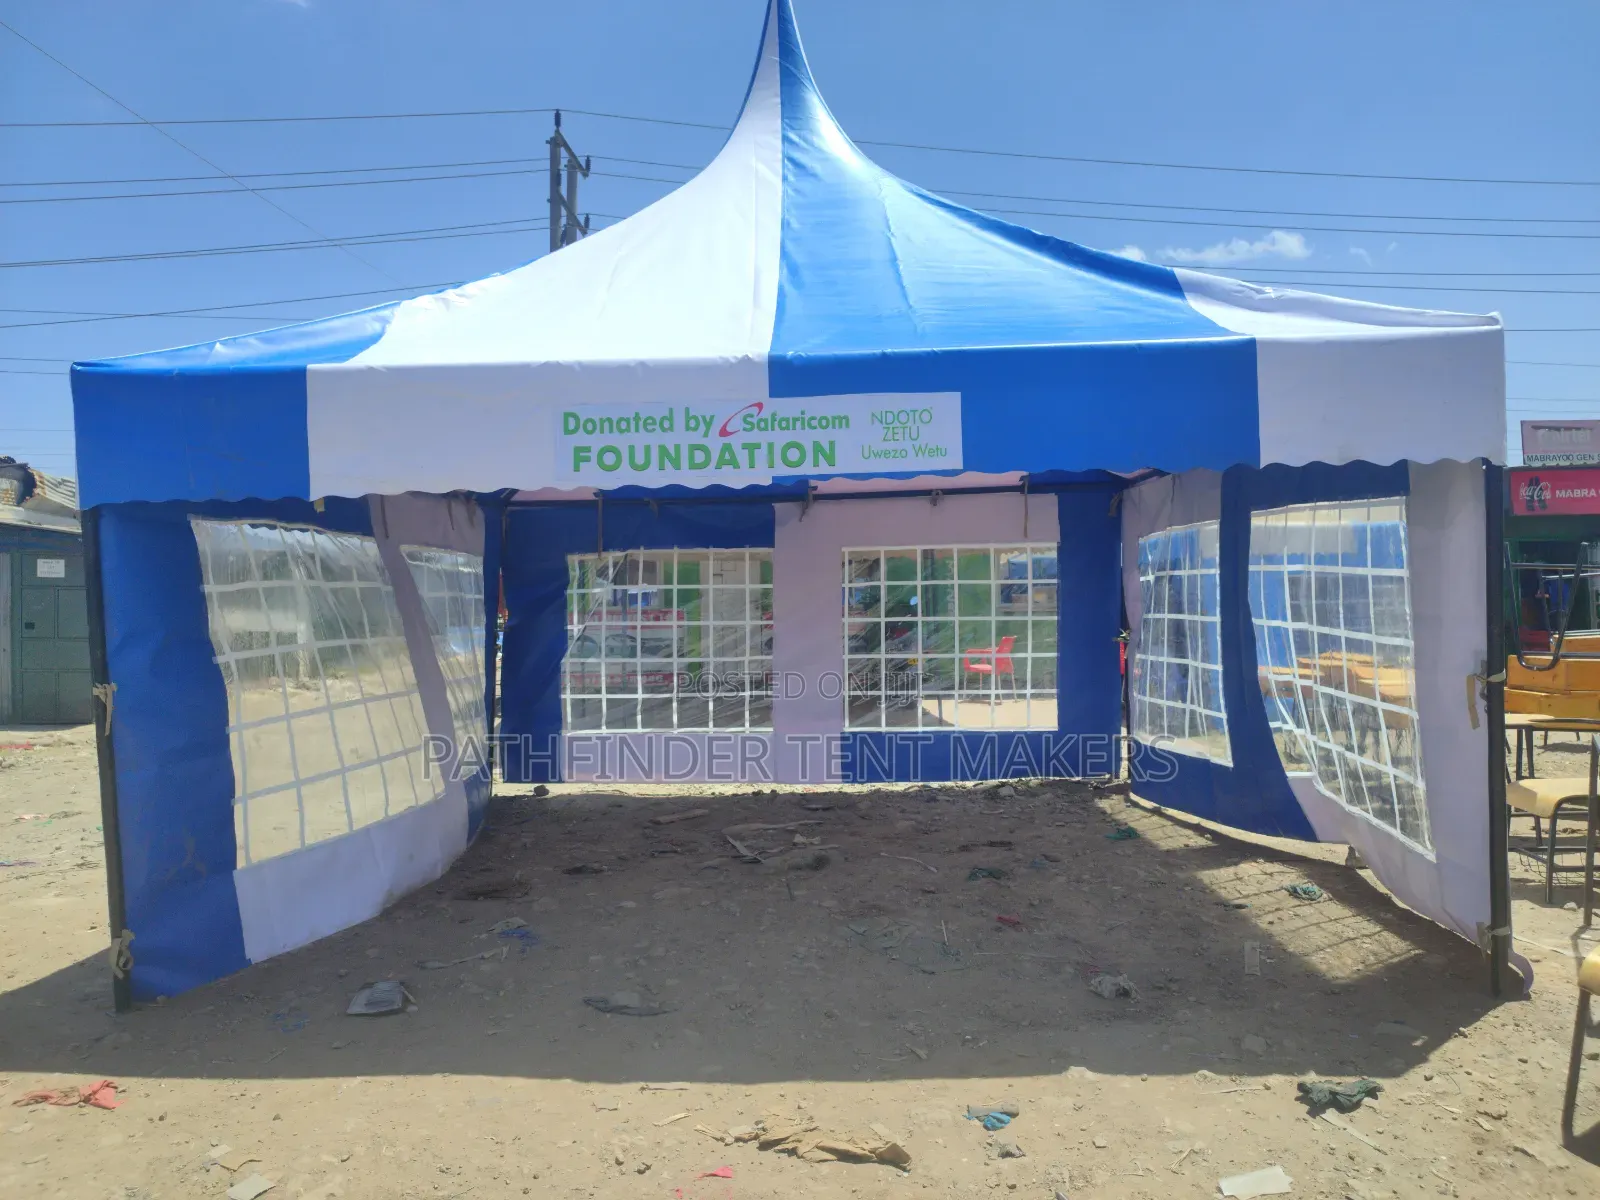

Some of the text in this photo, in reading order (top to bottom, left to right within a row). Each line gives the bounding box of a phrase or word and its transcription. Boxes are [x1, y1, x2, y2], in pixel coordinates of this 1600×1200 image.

[563, 406, 850, 438] Donated by Safaricom
[871, 408, 933, 425] NDOTO
[882, 426, 920, 442] ZETU
[573, 440, 836, 472] FOUNDATION
[861, 442, 948, 460] Uwezo Wetu
[1576, 453, 1595, 461] GEN
[1555, 488, 1597, 498] MABRA
